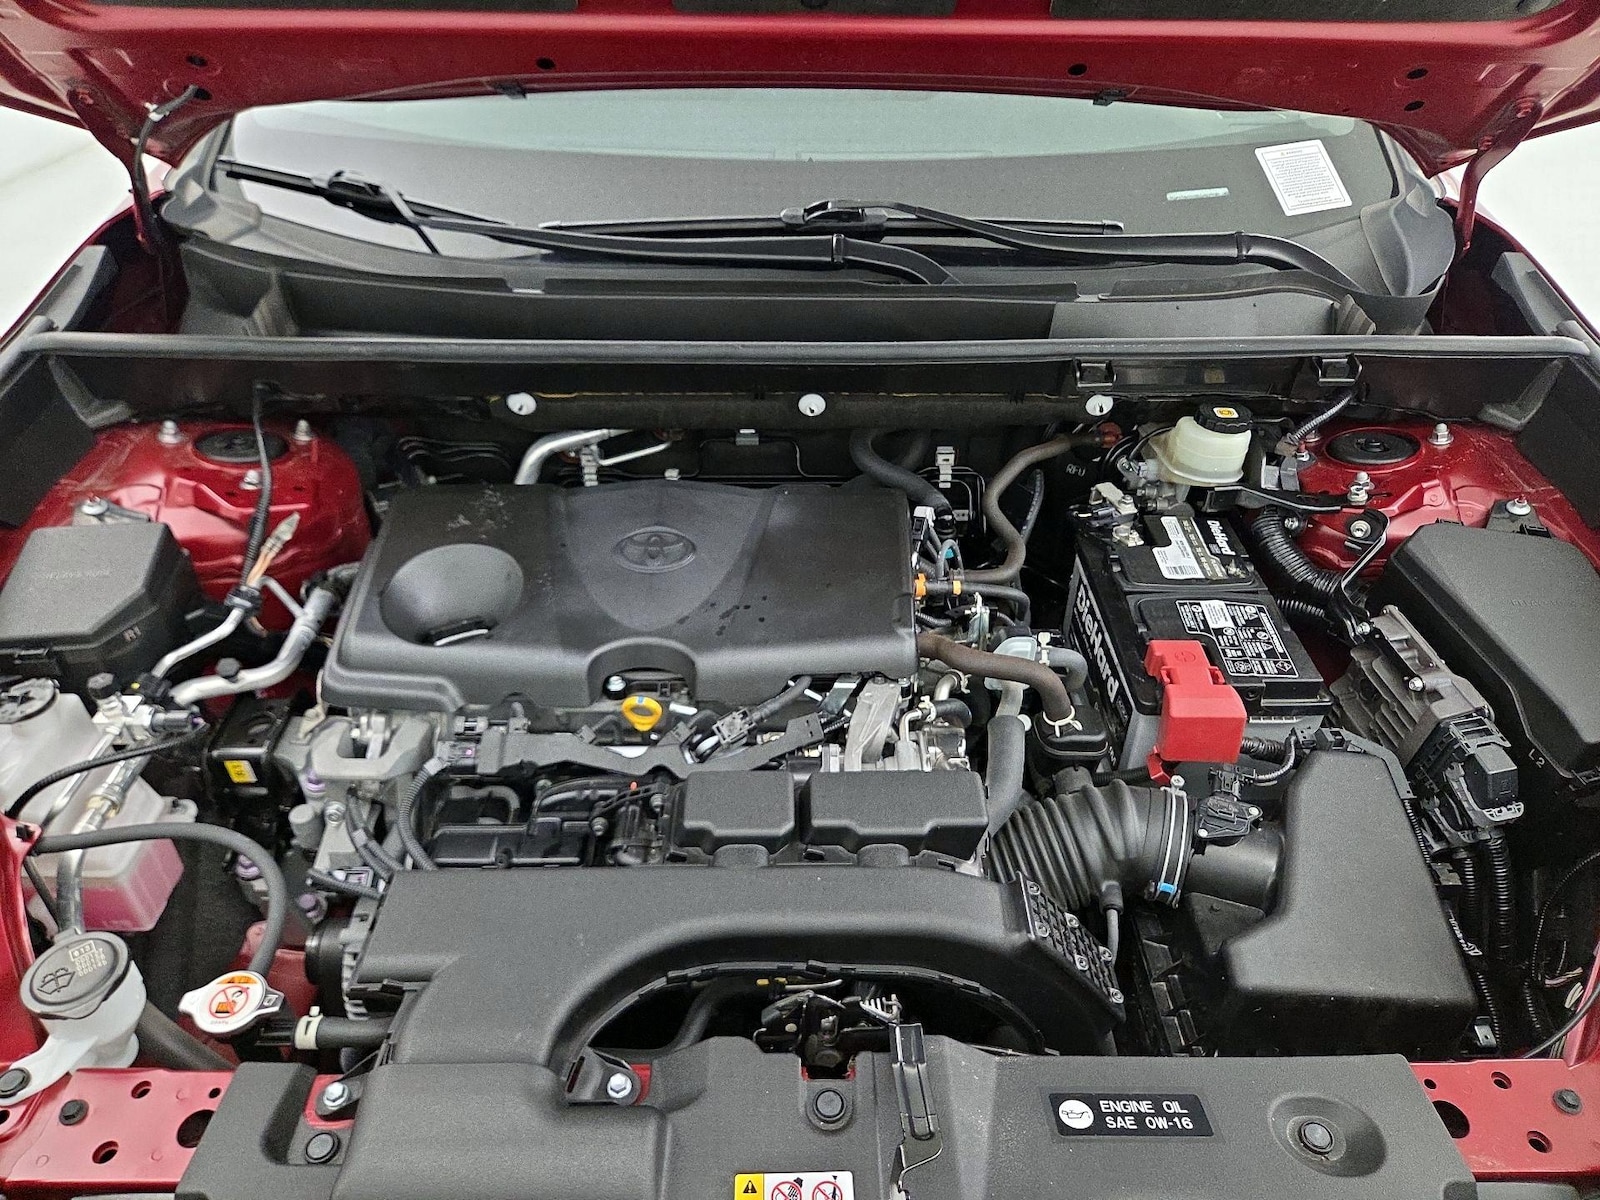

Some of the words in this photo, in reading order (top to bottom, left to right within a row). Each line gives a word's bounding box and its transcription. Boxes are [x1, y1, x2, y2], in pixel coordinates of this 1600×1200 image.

[1206, 520, 1236, 556] DieHard
[1076, 584, 1119, 703] DieHard
[1099, 1100, 1155, 1113] ENGINE
[1162, 1100, 1189, 1114] OIL
[1105, 1116, 1138, 1130] SAE
[1145, 1116, 1194, 1130] 0W-16
